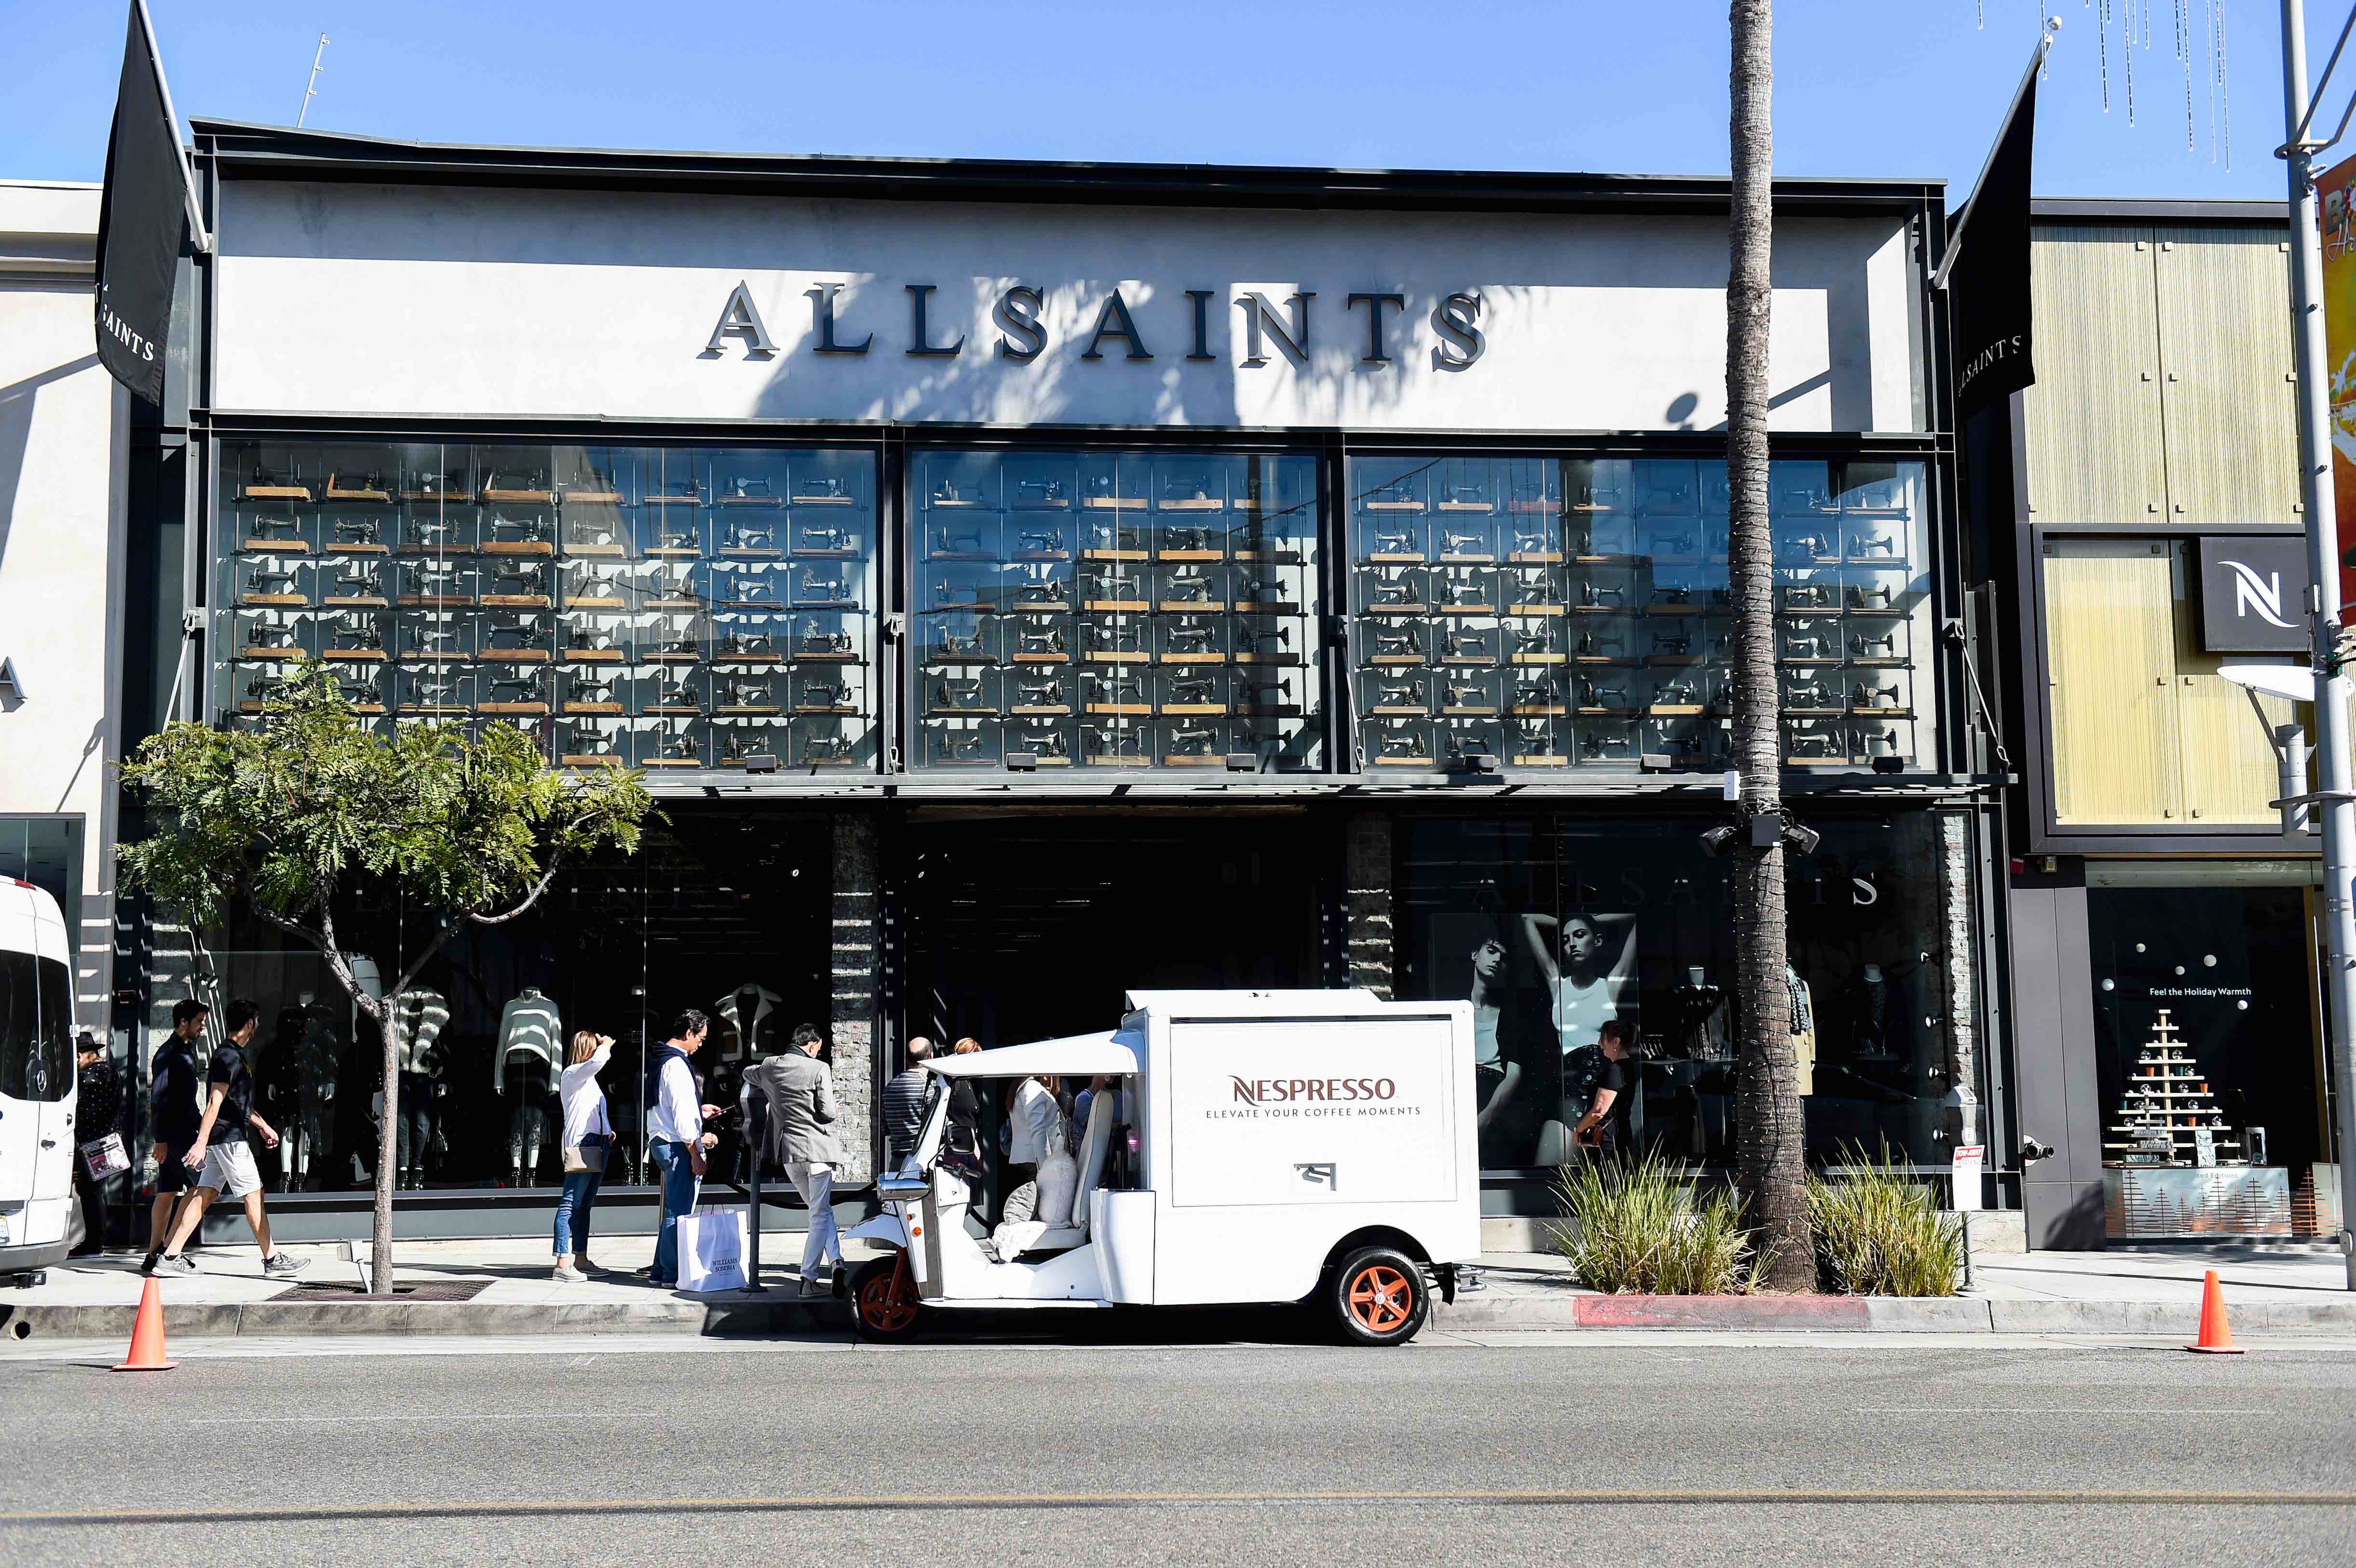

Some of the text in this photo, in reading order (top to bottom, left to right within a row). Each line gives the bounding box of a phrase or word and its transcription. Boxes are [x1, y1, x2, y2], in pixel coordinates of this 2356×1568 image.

[705, 279, 1486, 364] ALLSAINTS
[2184, 988, 2217, 997] Holiday
[1227, 1075, 1395, 1107] NESPRESSO
[1206, 1107, 1420, 1118] ELEVATE YOUR COFFEE MOMENTS
[712, 1257, 737, 1266] WILLIAMS
